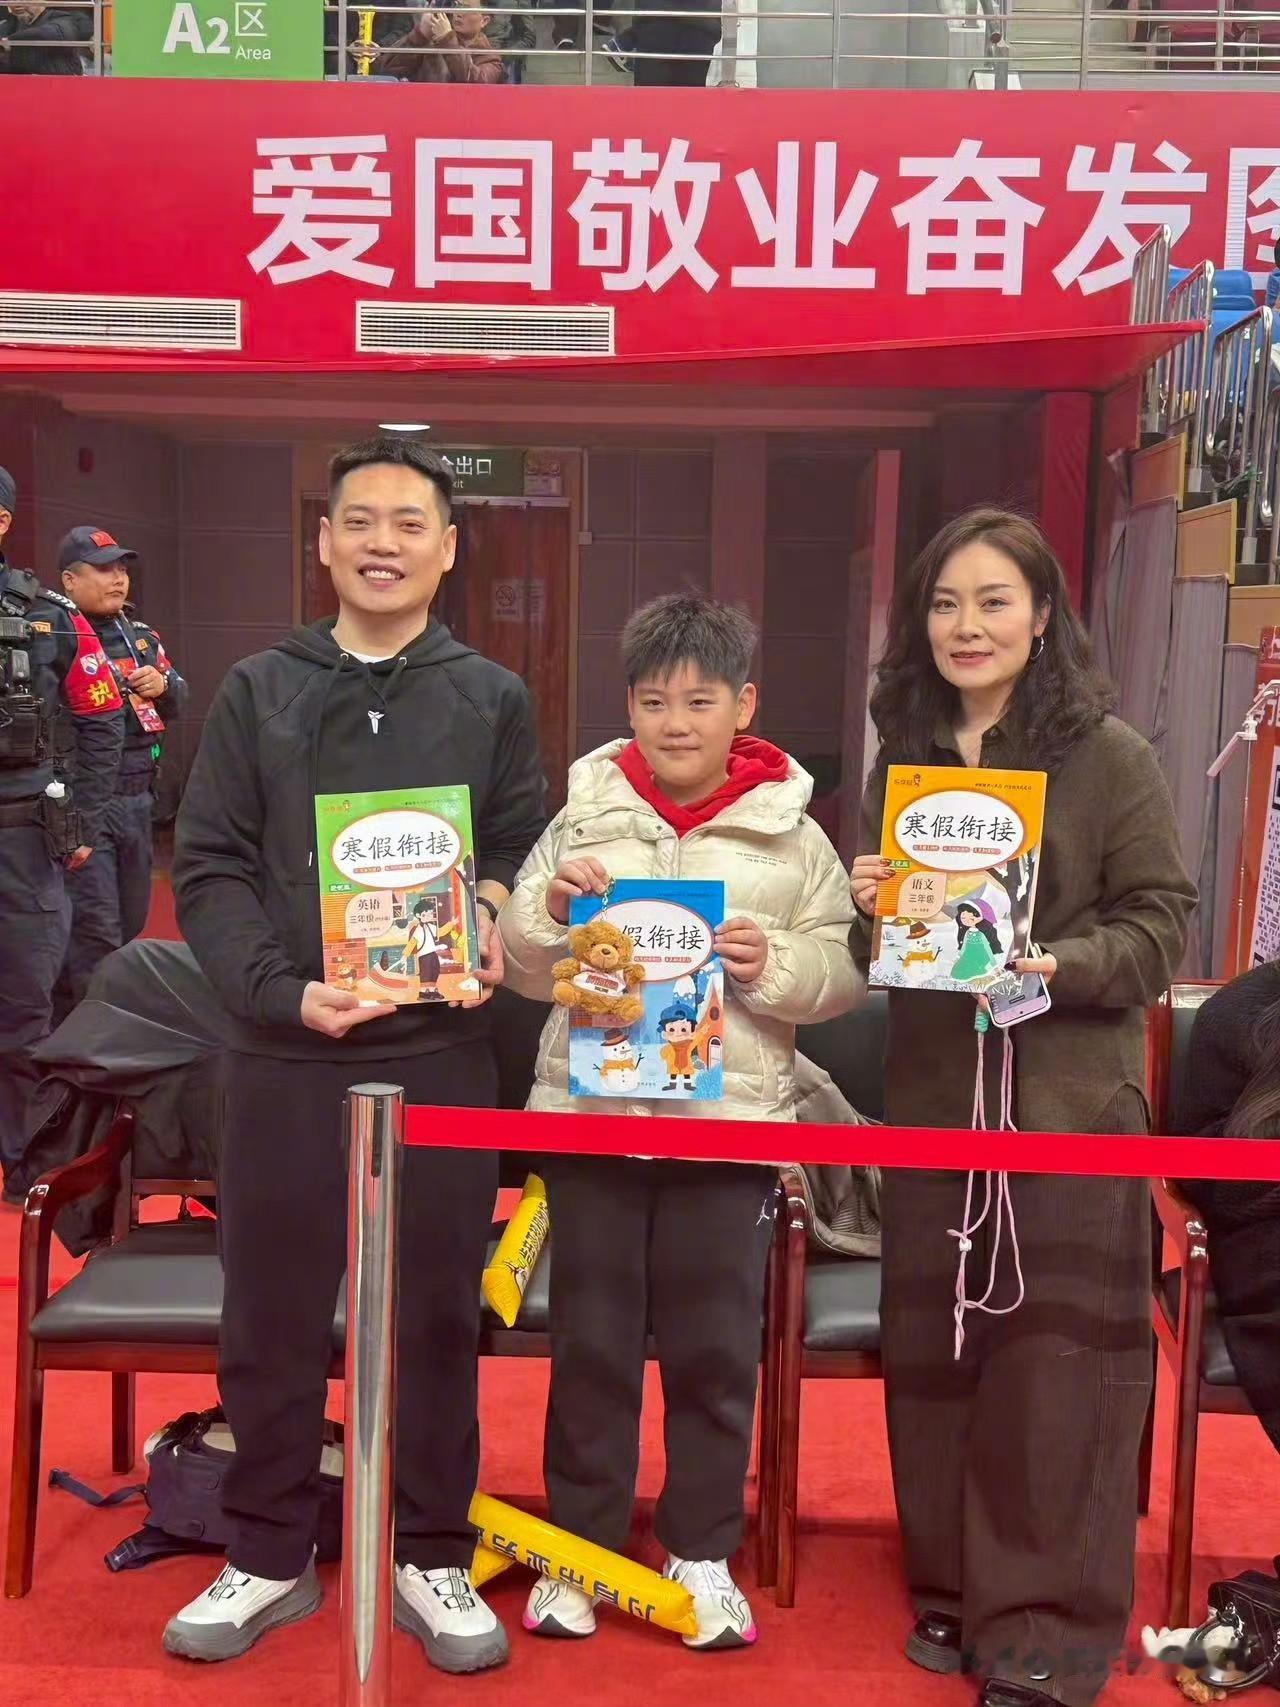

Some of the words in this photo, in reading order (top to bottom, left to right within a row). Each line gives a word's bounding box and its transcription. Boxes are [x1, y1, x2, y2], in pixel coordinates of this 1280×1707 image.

[162, 3, 231, 54] A2
[235, 45, 271, 60] Area
[902, 812, 1017, 842] 寒假衔接
[340, 830, 454, 862] 寒假衔接
[912, 878, 934, 891] 语文
[358, 898, 380, 911] 英语
[622, 924, 705, 950] 假衔接
